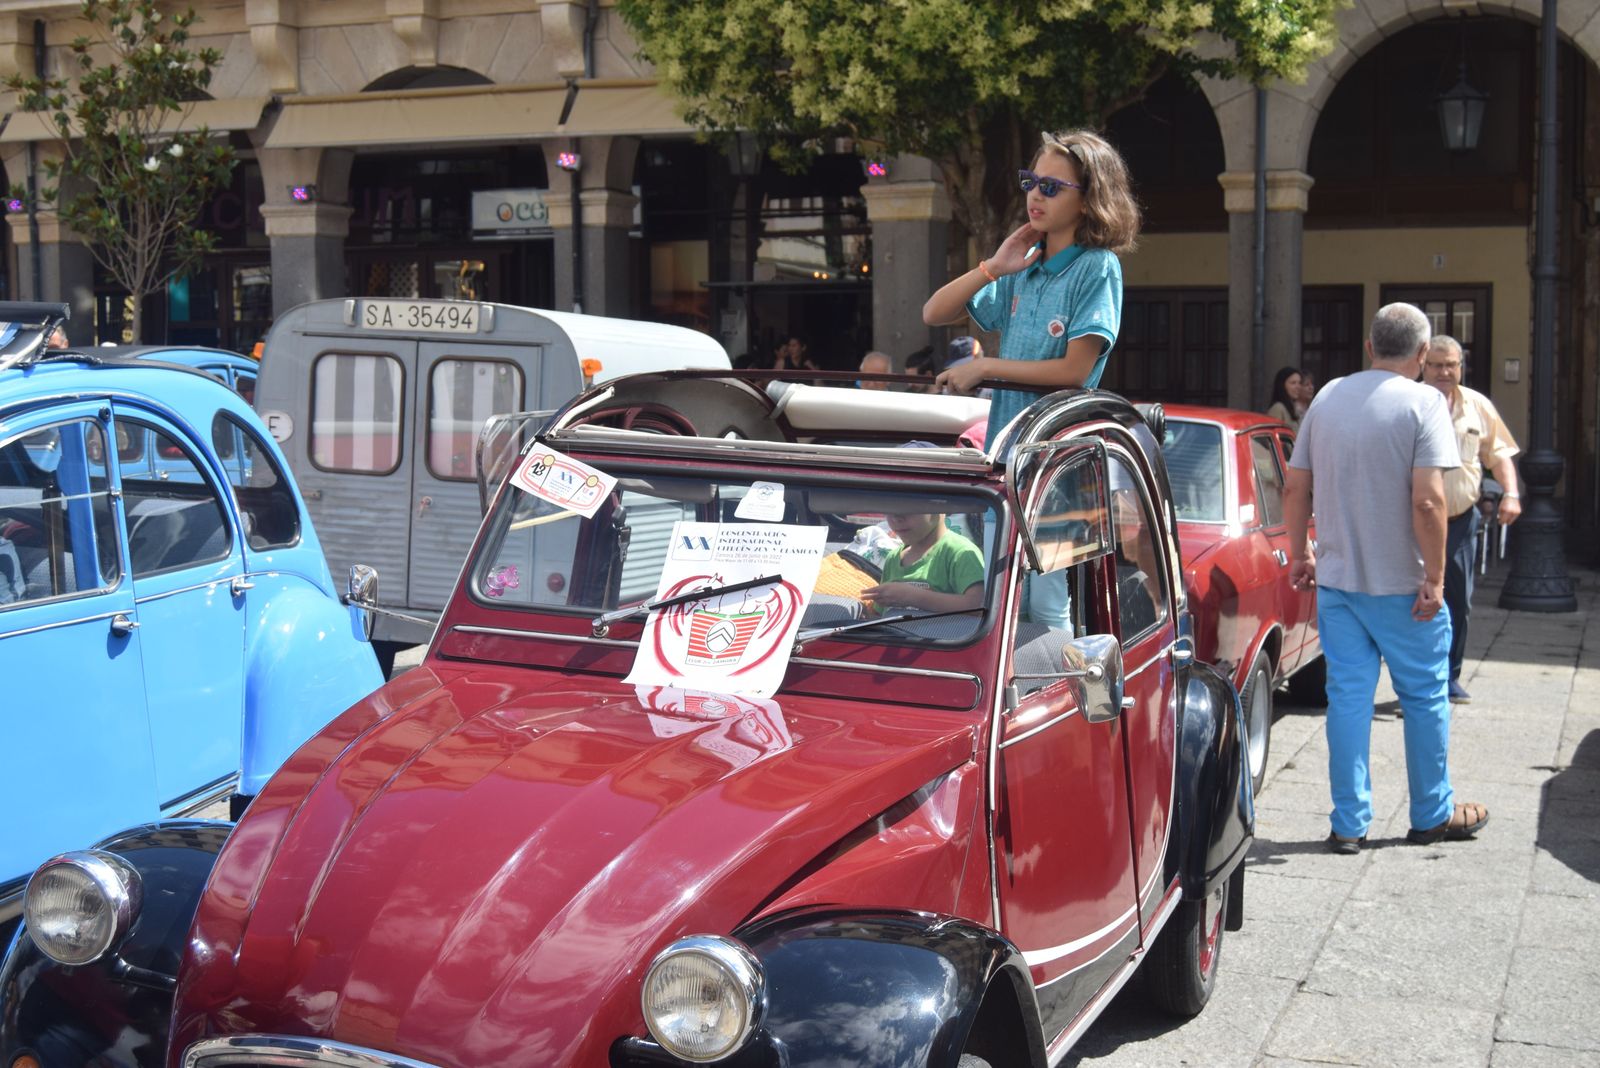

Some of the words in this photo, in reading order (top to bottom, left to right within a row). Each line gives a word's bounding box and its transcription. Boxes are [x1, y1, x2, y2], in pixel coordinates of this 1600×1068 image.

[269, 415, 280, 439] E
[677, 535, 714, 550] XX
[719, 538, 782, 546] INTERNACIONAL
